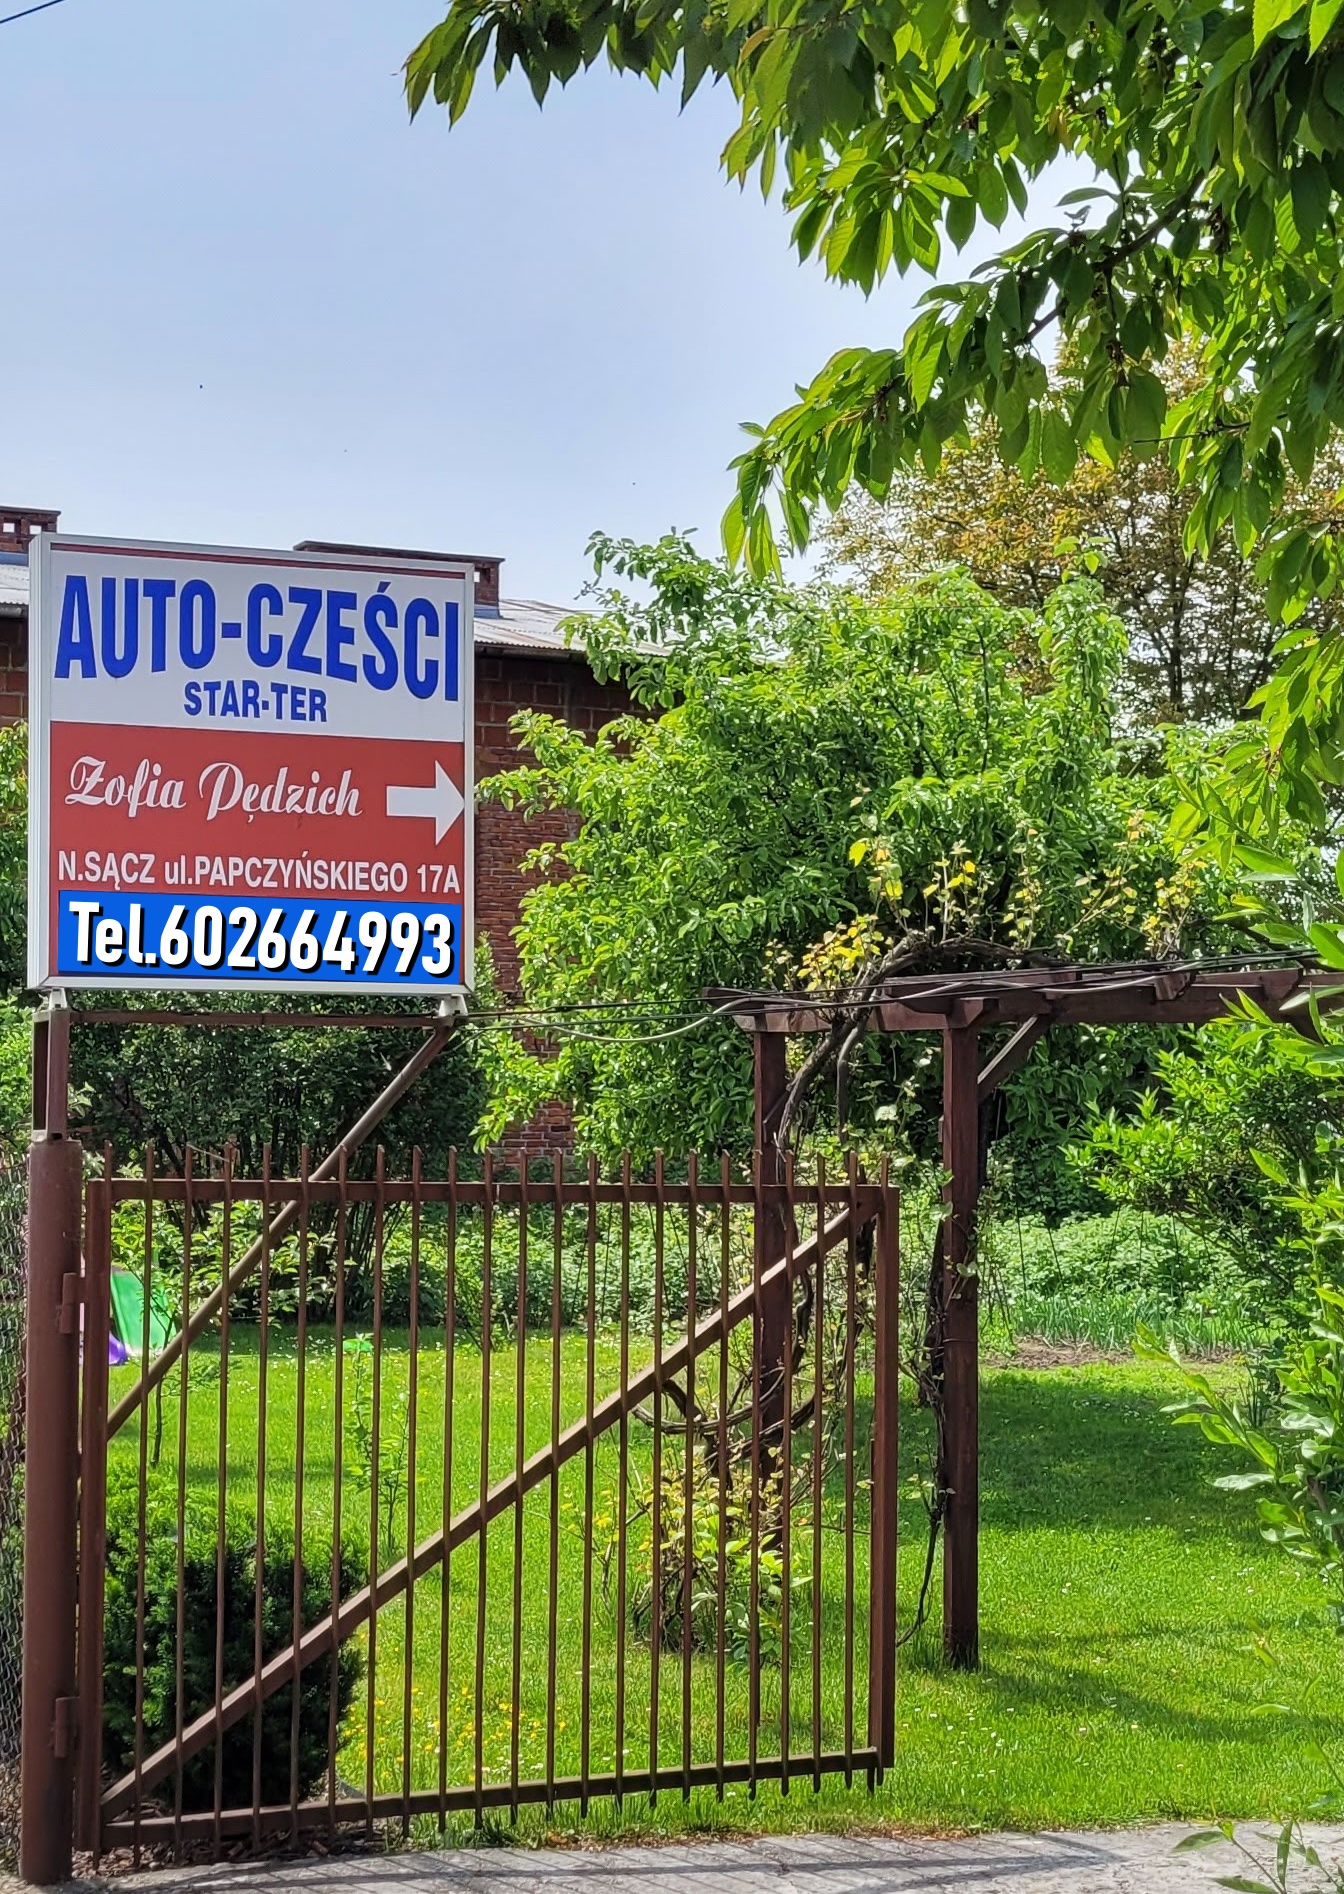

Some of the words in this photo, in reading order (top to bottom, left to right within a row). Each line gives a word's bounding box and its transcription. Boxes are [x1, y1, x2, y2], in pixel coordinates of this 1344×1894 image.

[64, 755, 187, 818] Zofia
[198, 761, 363, 823] Pędzich
[58, 850, 155, 890] N.SĄCZ
[163, 850, 408, 893] ul.PAPCZYŃSKIEGO
[416, 864, 461, 894] 17A
[68, 900, 455, 977] Tel.602664993
